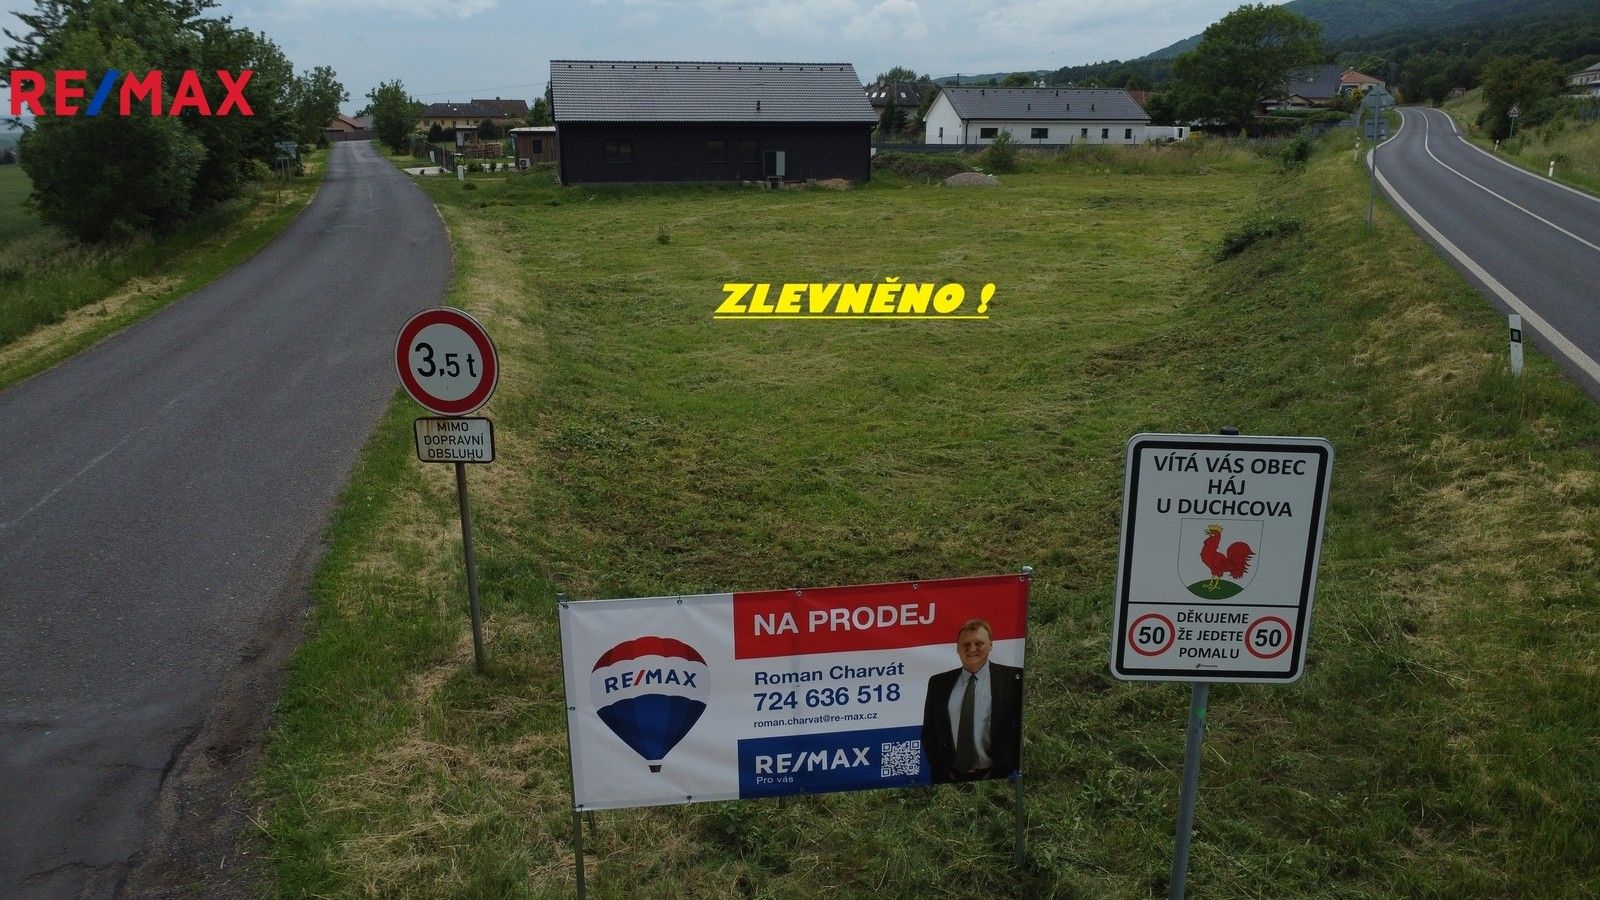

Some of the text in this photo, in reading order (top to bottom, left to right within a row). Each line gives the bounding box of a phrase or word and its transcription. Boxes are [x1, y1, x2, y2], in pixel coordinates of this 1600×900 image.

[415, 342, 477, 378] 3,5 t
[437, 421, 469, 432] MIMO
[424, 433, 484, 446] DOPRAVNÍ
[428, 448, 484, 459] OBSLUHU
[1154, 452, 1306, 476] VÍTÁ VÁS OBEC
[1208, 475, 1246, 496] HÁJ
[1156, 498, 1293, 517] U DUCHCOVA
[754, 602, 936, 636] NA PRODEJ
[1176, 609, 1249, 624] DĚKUJEME
[1138, 626, 1165, 645] 50
[1177, 626, 1243, 642] ŽE JEDETE
[1254, 628, 1282, 647] 50
[1178, 646, 1240, 660] POMALU
[604, 668, 697, 694] RE/MAX
[754, 662, 904, 686] Roman Charvát
[753, 683, 901, 712] 724 636 518
[753, 711, 878, 729] roman.charvat@re-max.cz
[755, 746, 871, 775] RE/MAX
[756, 775, 794, 785] Pro vás
